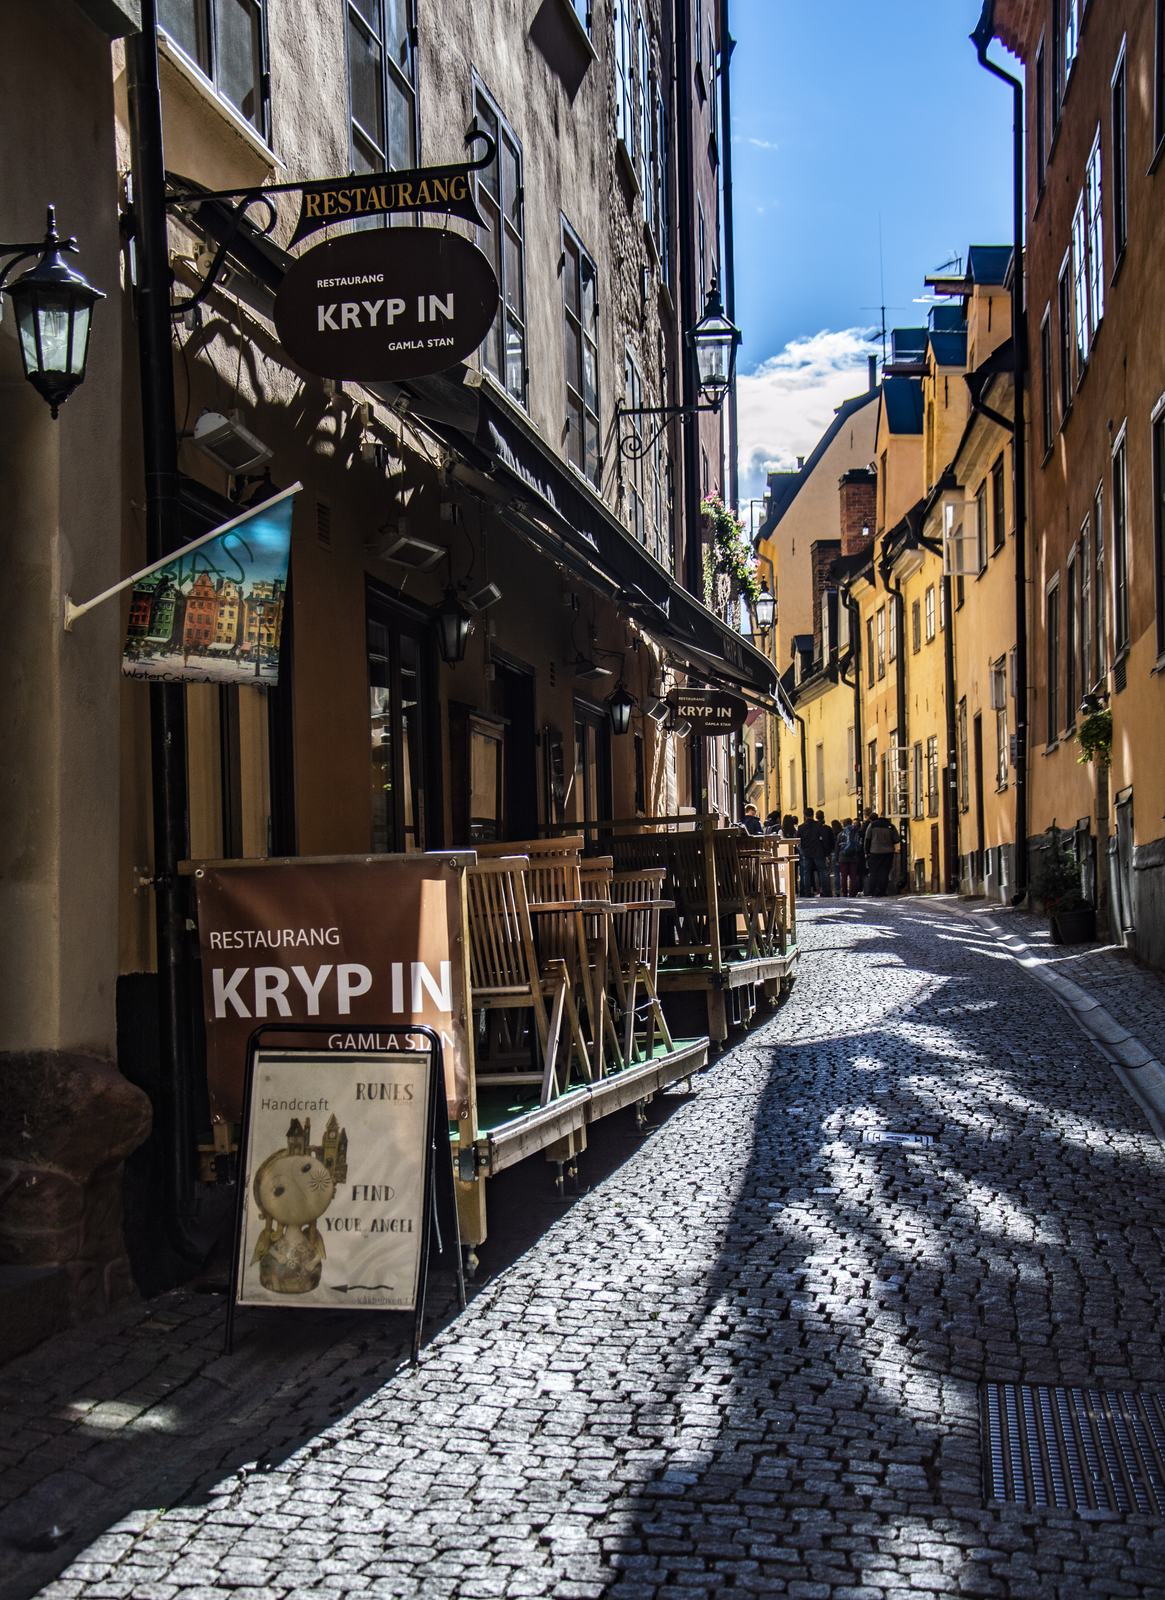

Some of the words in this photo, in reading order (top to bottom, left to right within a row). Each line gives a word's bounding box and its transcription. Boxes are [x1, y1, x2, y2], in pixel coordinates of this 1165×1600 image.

[304, 175, 468, 218] RESTAURANG
[316, 273, 385, 289] RESTAURANG
[317, 298, 406, 332] KRYP
[417, 292, 455, 323] IN
[388, 339, 425, 351] GAMLA
[427, 337, 455, 349] STAN
[677, 705, 713, 718] KRYP
[716, 706, 732, 718] IN
[209, 927, 341, 950] RESTAURANG
[211, 962, 374, 1019] KRYP
[390, 960, 453, 1015] IN
[327, 1032, 400, 1051] GAMLA
[355, 1082, 415, 1102] RUNES
[261, 1097, 330, 1112] Handcraft
[351, 1184, 396, 1202] FIND
[325, 1217, 362, 1232] YOUR
[370, 1218, 415, 1233] ANGEL
